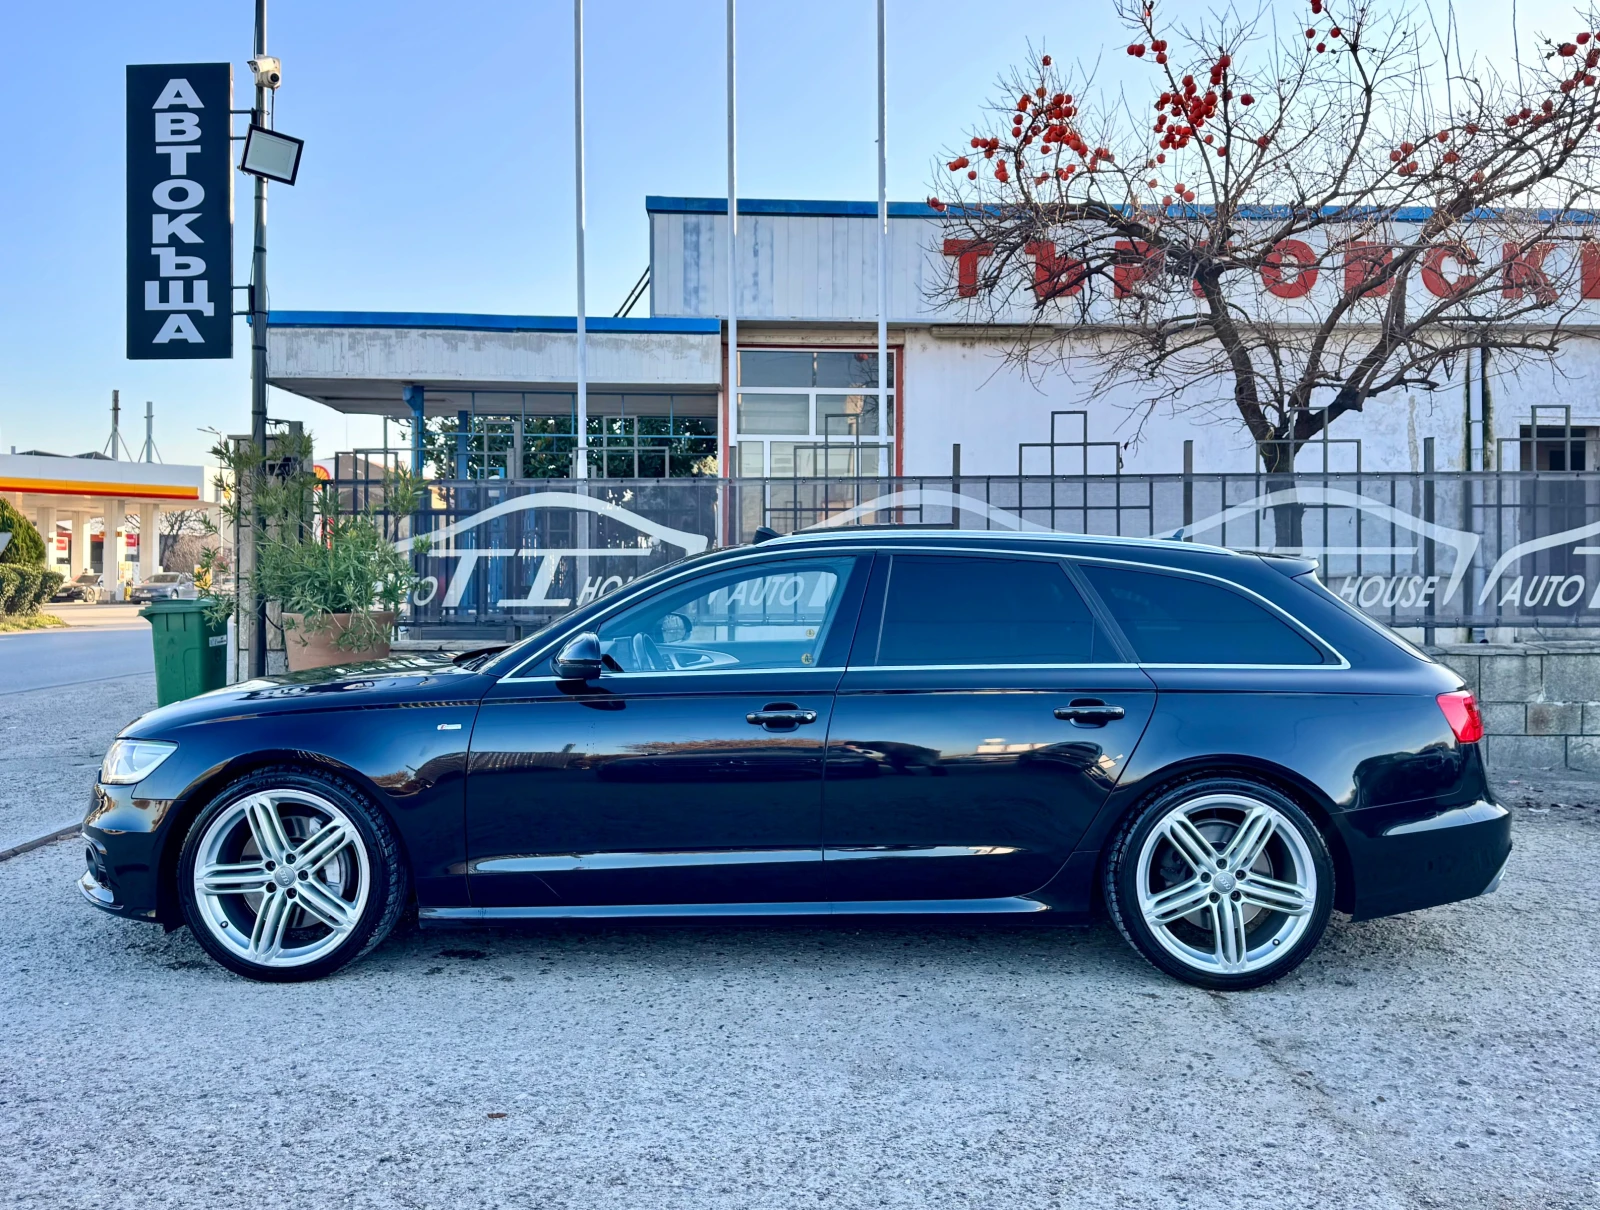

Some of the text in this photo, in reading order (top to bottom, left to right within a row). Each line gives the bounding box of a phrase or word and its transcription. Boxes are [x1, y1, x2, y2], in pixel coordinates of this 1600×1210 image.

[144, 78, 214, 344] АВТОКЪЩА
[725, 575, 805, 606] AUTO
[1340, 575, 1440, 608] HOUSE
[1497, 574, 1585, 607] AUTO
